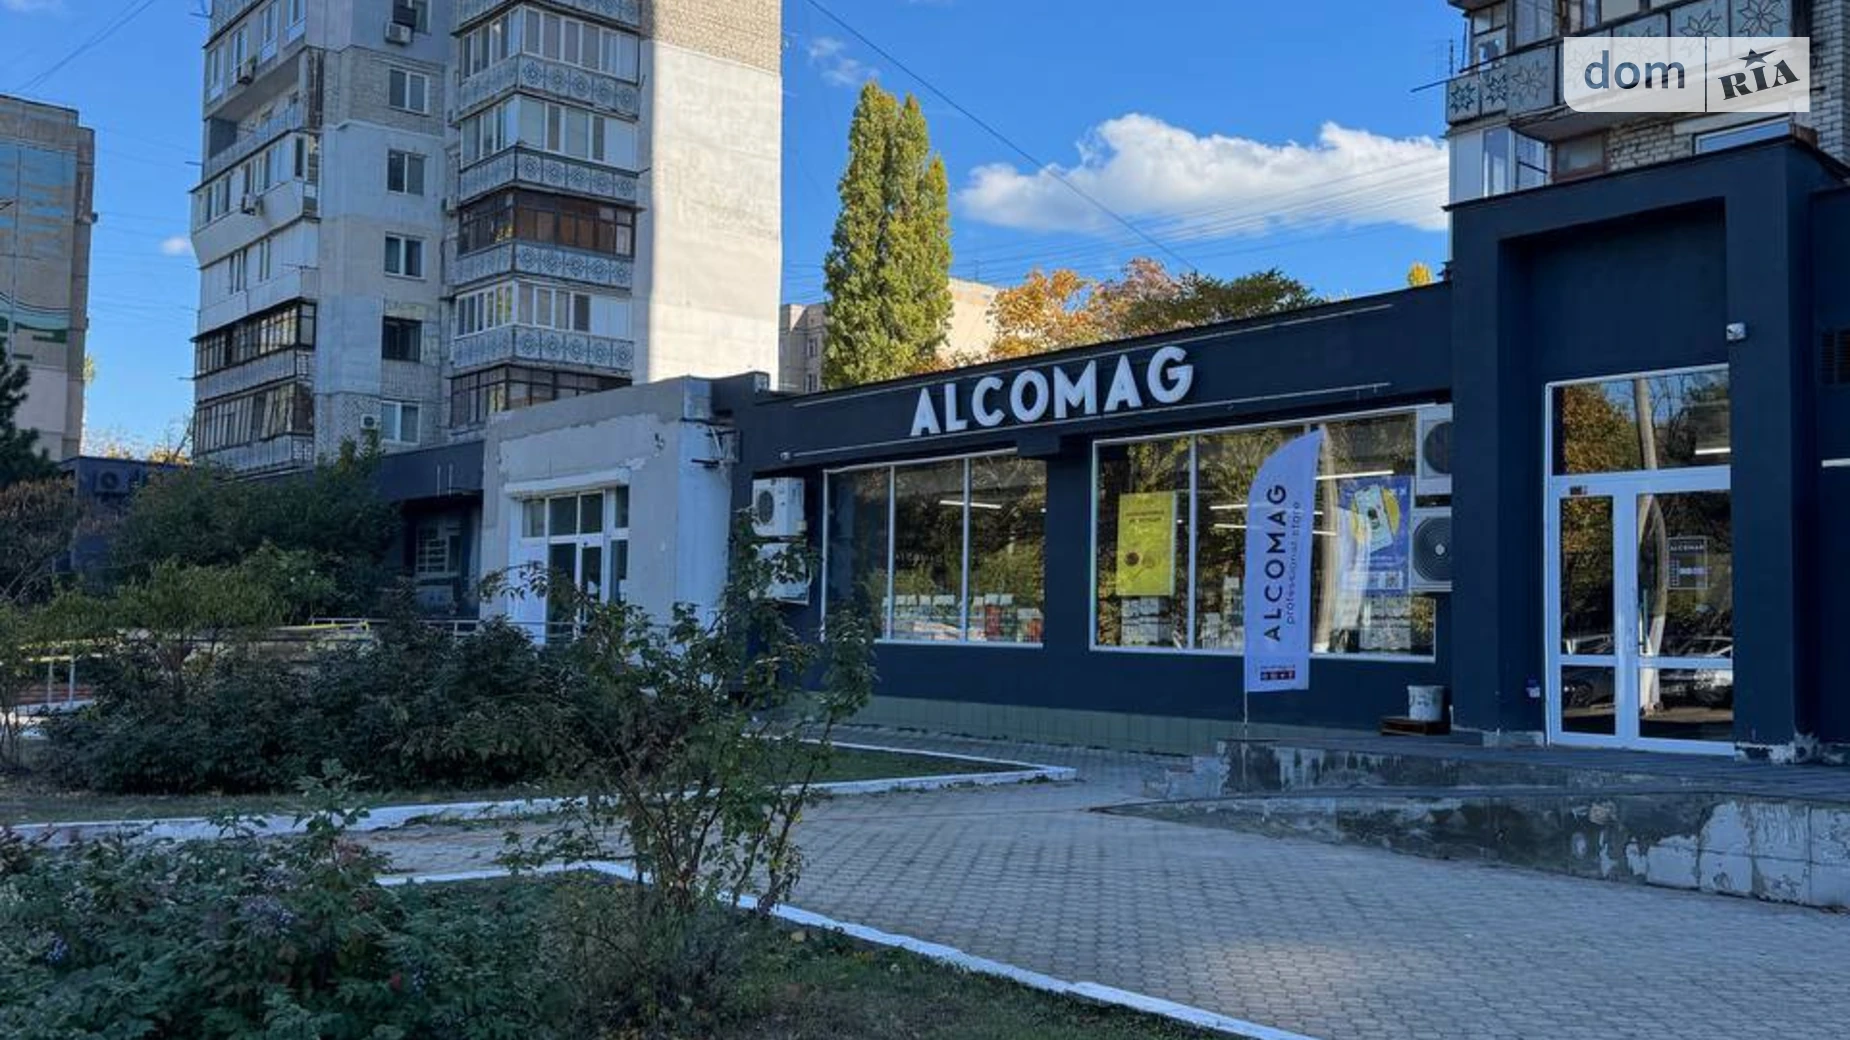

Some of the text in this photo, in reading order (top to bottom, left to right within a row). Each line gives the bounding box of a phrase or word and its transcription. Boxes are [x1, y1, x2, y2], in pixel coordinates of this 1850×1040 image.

[910, 346, 1194, 436] ALCOMAG
[1264, 484, 1287, 642] ALCOMAG
[1285, 501, 1301, 625] professional store
